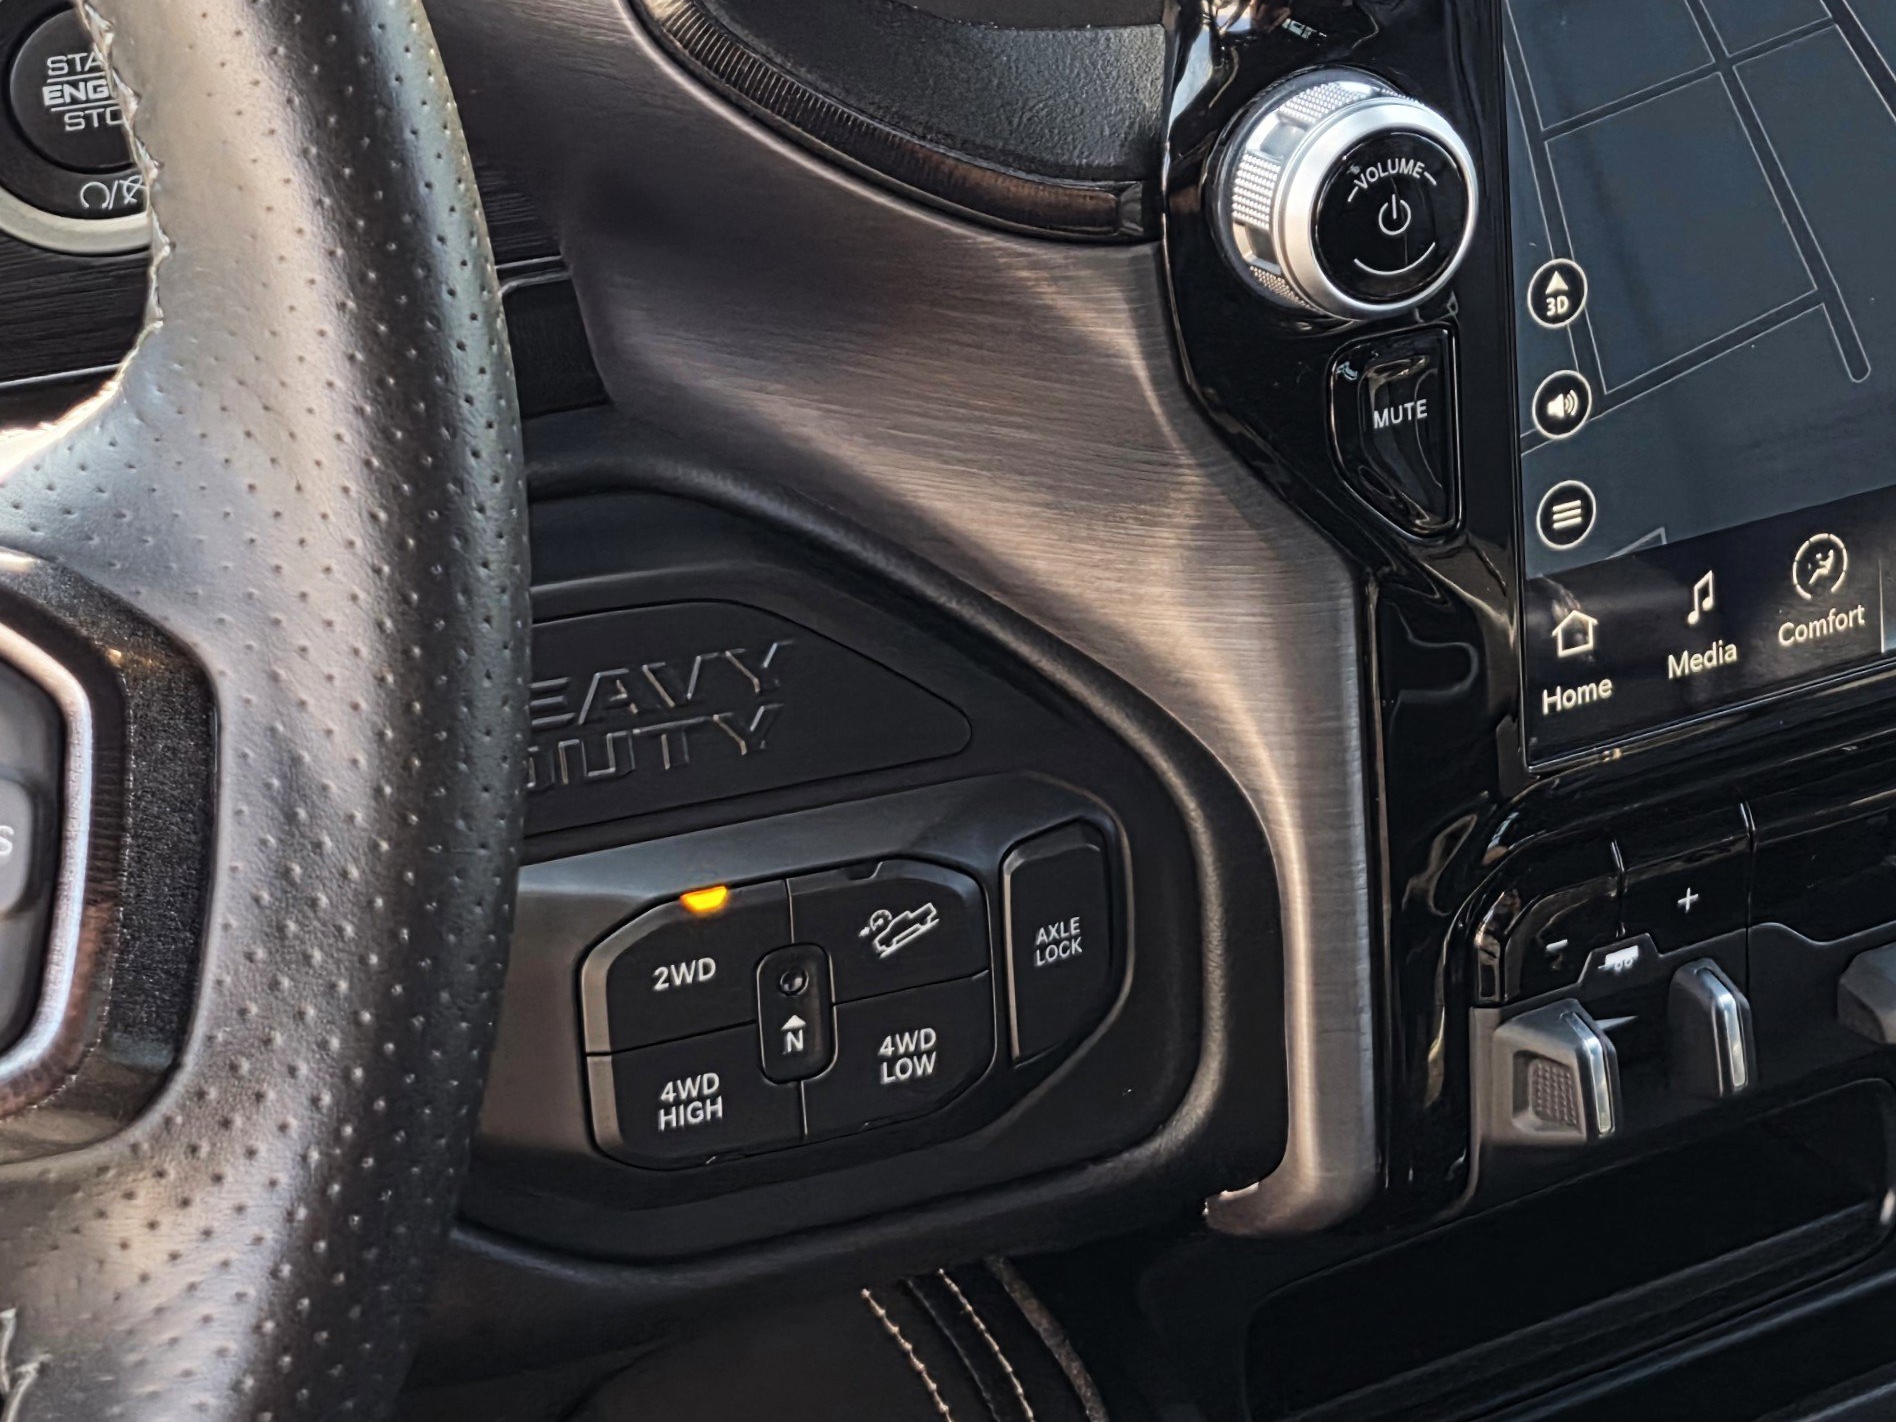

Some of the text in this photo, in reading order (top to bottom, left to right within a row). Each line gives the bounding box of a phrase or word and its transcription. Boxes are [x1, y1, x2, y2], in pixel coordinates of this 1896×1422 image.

[47, 51, 104, 76] STA
[42, 78, 110, 107] ENG
[63, 106, 124, 132] STO
[1354, 157, 1426, 190] VOLUME
[1545, 295, 1569, 317] 3D
[1373, 398, 1428, 429] MUTE
[1778, 604, 1865, 647] Comfort
[1667, 641, 1737, 679] Media
[526, 640, 794, 728] EAVY
[1541, 677, 1613, 715] Home
[1035, 916, 1081, 946] AXLE
[1035, 936, 1083, 968] LOCK
[653, 956, 716, 991] 2WD
[783, 1030, 804, 1054] N
[879, 1027, 937, 1057] 4WD
[880, 1052, 937, 1084] LOW
[660, 1071, 720, 1103] 4WD
[658, 1096, 723, 1132] HIGH
